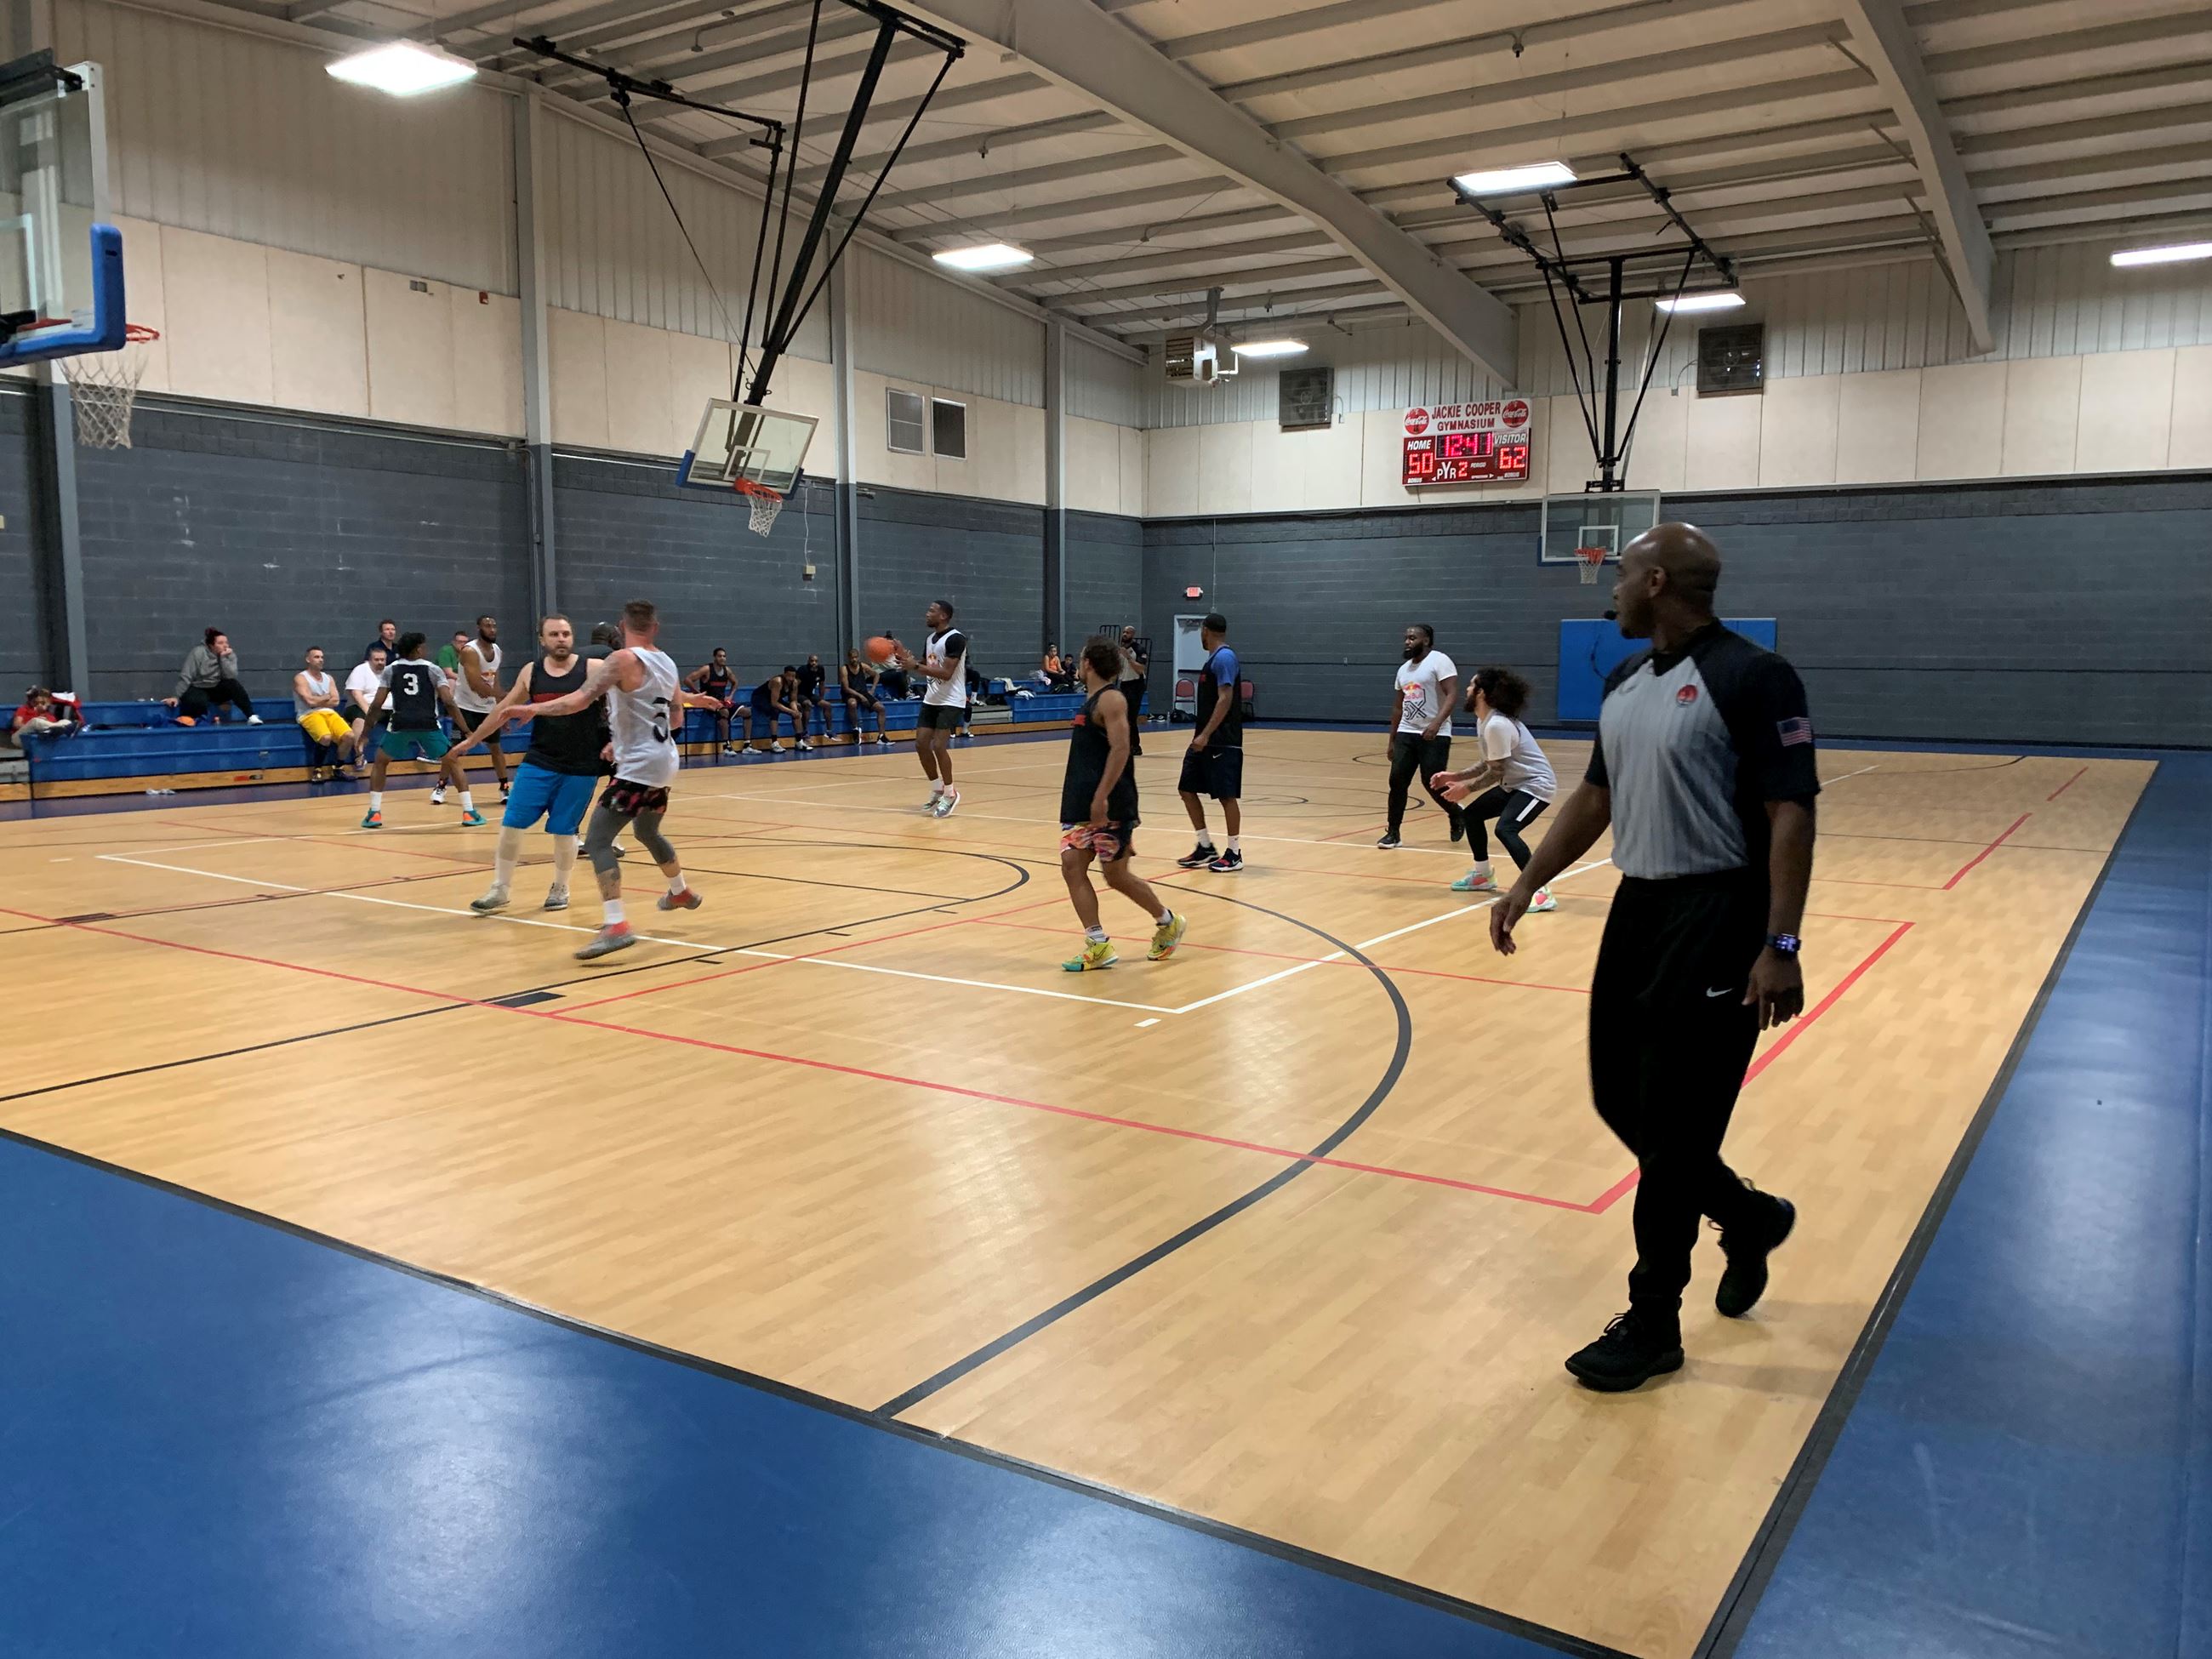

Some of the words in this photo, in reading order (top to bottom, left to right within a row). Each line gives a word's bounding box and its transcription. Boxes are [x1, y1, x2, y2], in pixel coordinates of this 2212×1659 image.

[1432, 407, 1461, 419] JACKIE
[1466, 402, 1501, 417] COOPER
[1437, 418, 1495, 431] GYMNASIUM
[1407, 440, 1432, 451] HOME
[1494, 433, 1526, 444] VISITOR
[1408, 453, 1434, 474] 50
[1499, 447, 1525, 469] 62
[1458, 461, 1468, 477] 2
[402, 673, 419, 695] 3
